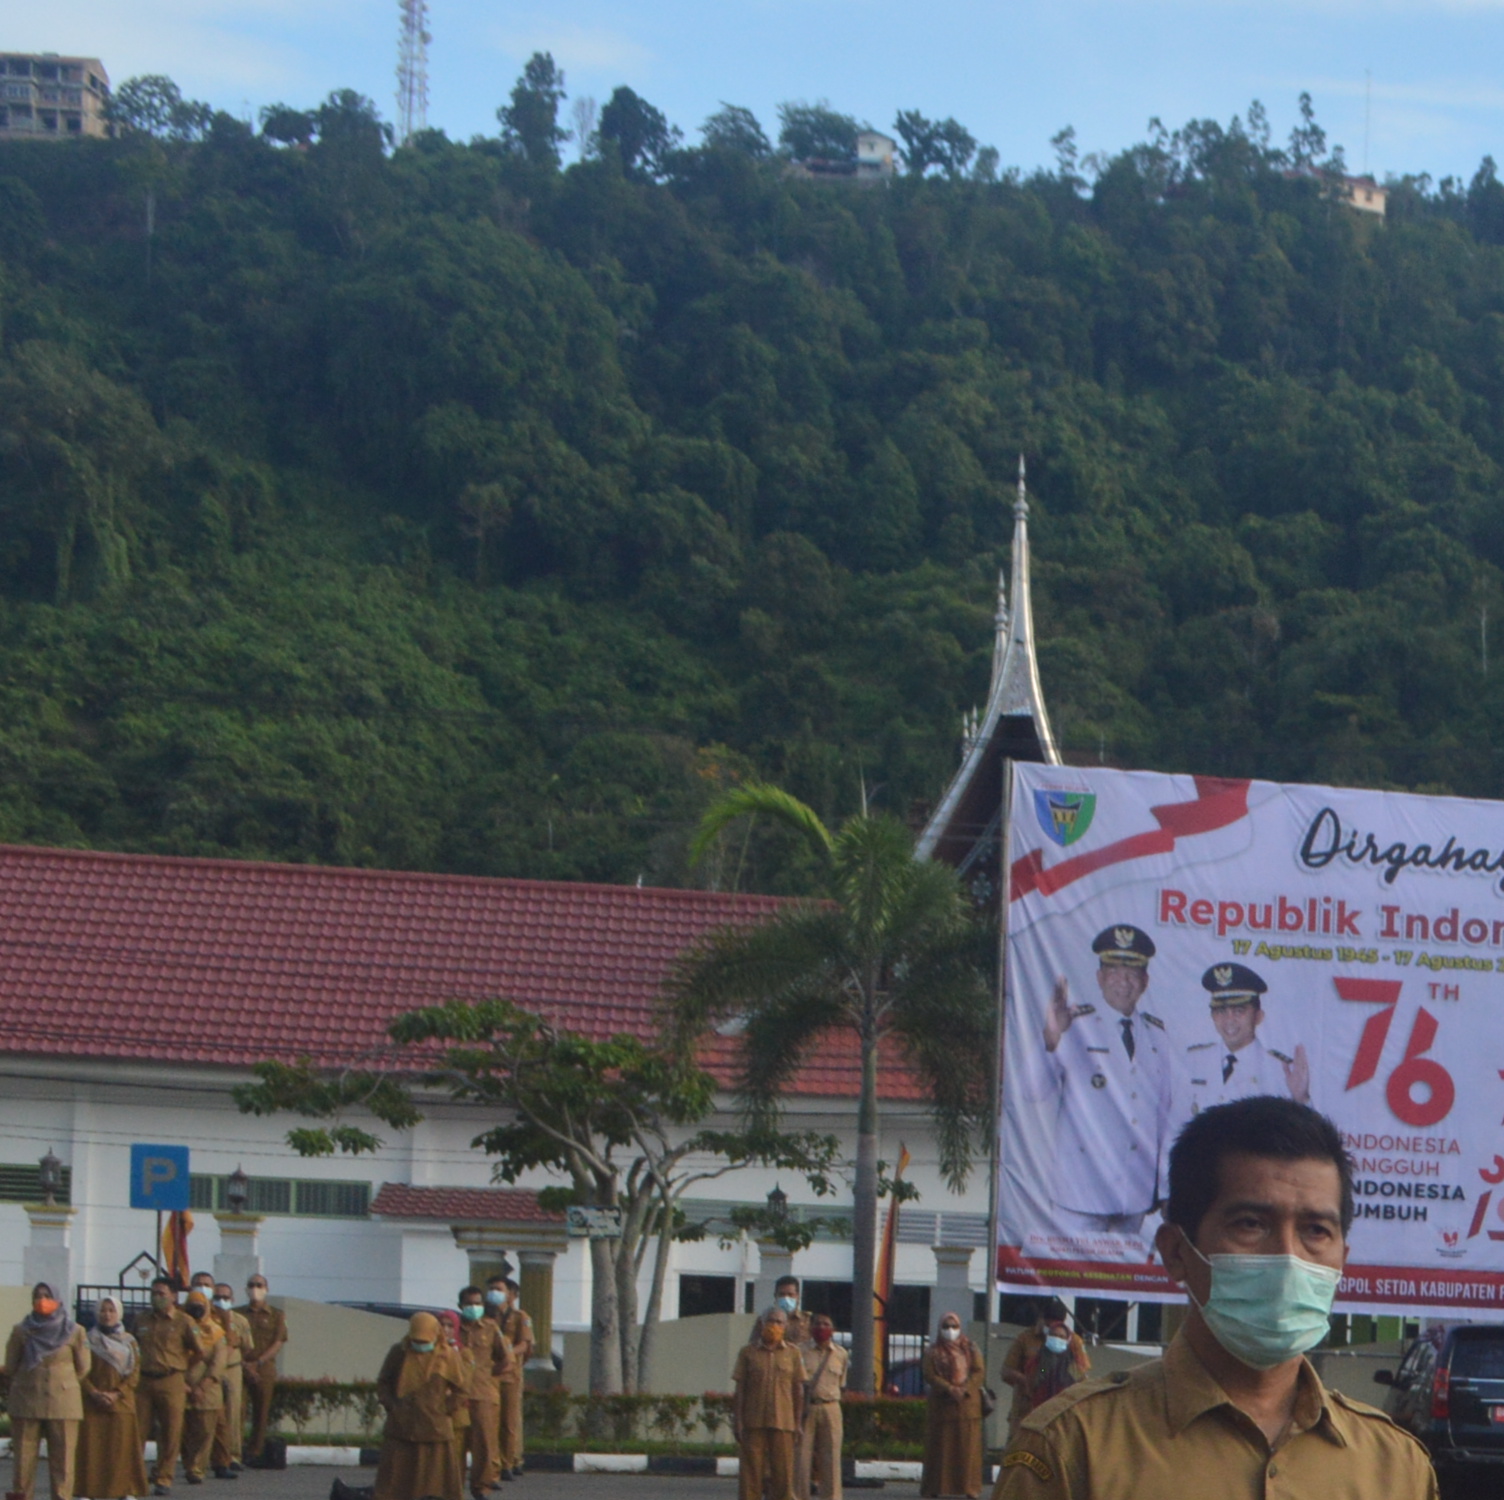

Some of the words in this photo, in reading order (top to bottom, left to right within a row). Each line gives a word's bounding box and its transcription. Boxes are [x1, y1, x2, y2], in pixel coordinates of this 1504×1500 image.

[1159, 889, 1361, 936] Republik
[1232, 939, 1252, 955] 17
[1255, 941, 1332, 961] Agustus
[1337, 946, 1378, 963] 1945
[1394, 949, 1413, 965] 17
[1416, 953, 1493, 971] Agustus
[1428, 982, 1459, 1001] TH
[1332, 976, 1456, 1127] 76
[143, 1157, 177, 1196] P
[1349, 1157, 1439, 1177] ANGGUH
[1350, 1180, 1465, 1201] NDONESIA
[1352, 1202, 1428, 1221] UMBUH
[1134, 1274, 1169, 1283] DENGAN
[1376, 1279, 1416, 1297] SETDA
[1420, 1280, 1495, 1299] KABUPATEN
